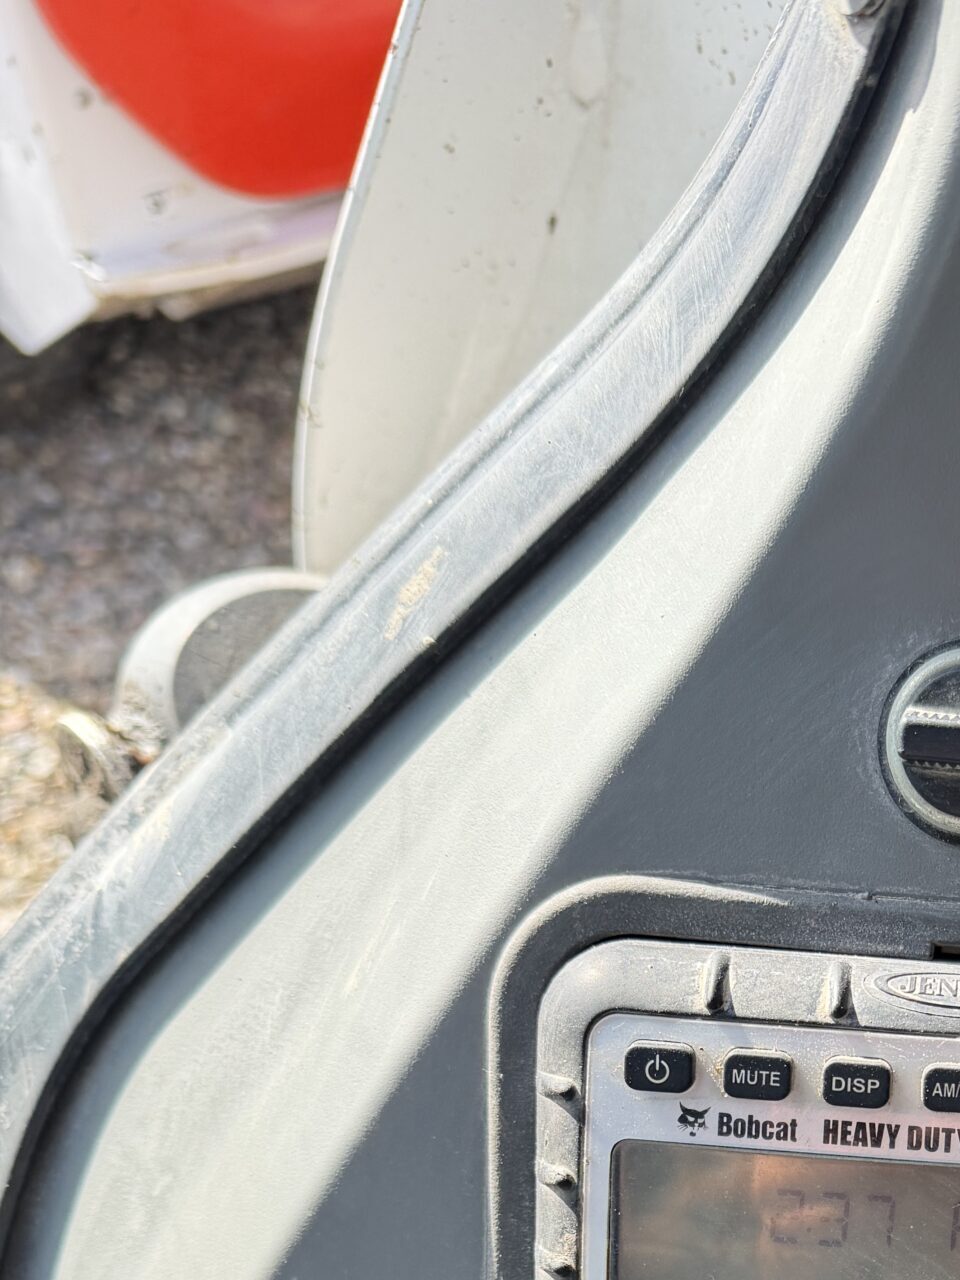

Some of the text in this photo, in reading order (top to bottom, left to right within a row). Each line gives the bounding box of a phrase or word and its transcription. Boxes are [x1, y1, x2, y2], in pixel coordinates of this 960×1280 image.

[732, 1068, 781, 1087] MUTE
[831, 1075, 880, 1094] DISP
[717, 1112, 798, 1142] Bobcat
[823, 1119, 900, 1150] HEAVY
